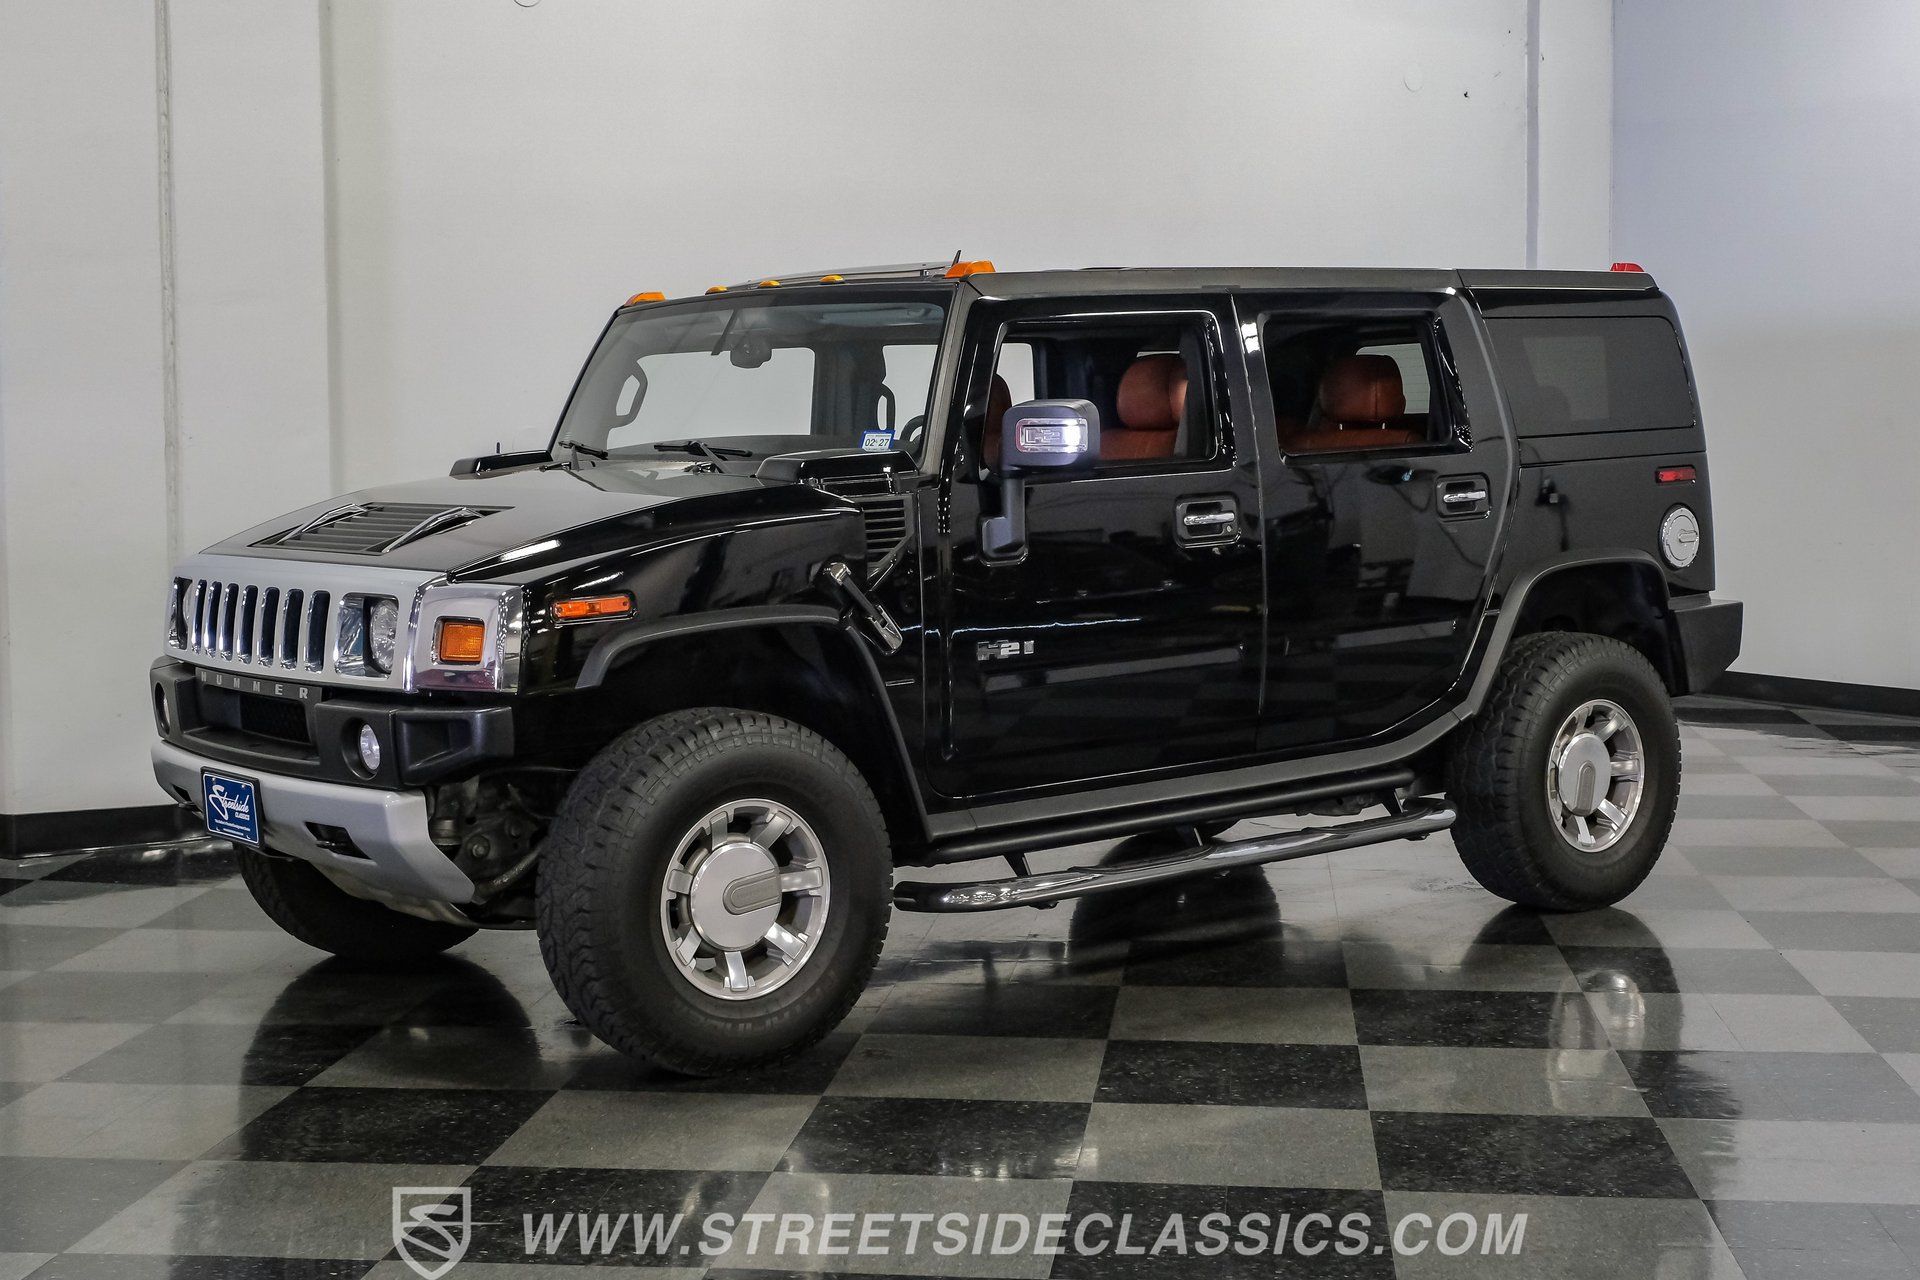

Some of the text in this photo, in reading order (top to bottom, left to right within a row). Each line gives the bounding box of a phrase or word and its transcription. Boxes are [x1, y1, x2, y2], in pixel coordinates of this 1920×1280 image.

[865, 438, 889, 447] 02 27
[977, 639, 1020, 661] H2
[200, 671, 309, 700] HUMMER
[208, 785, 250, 820] Streetside
